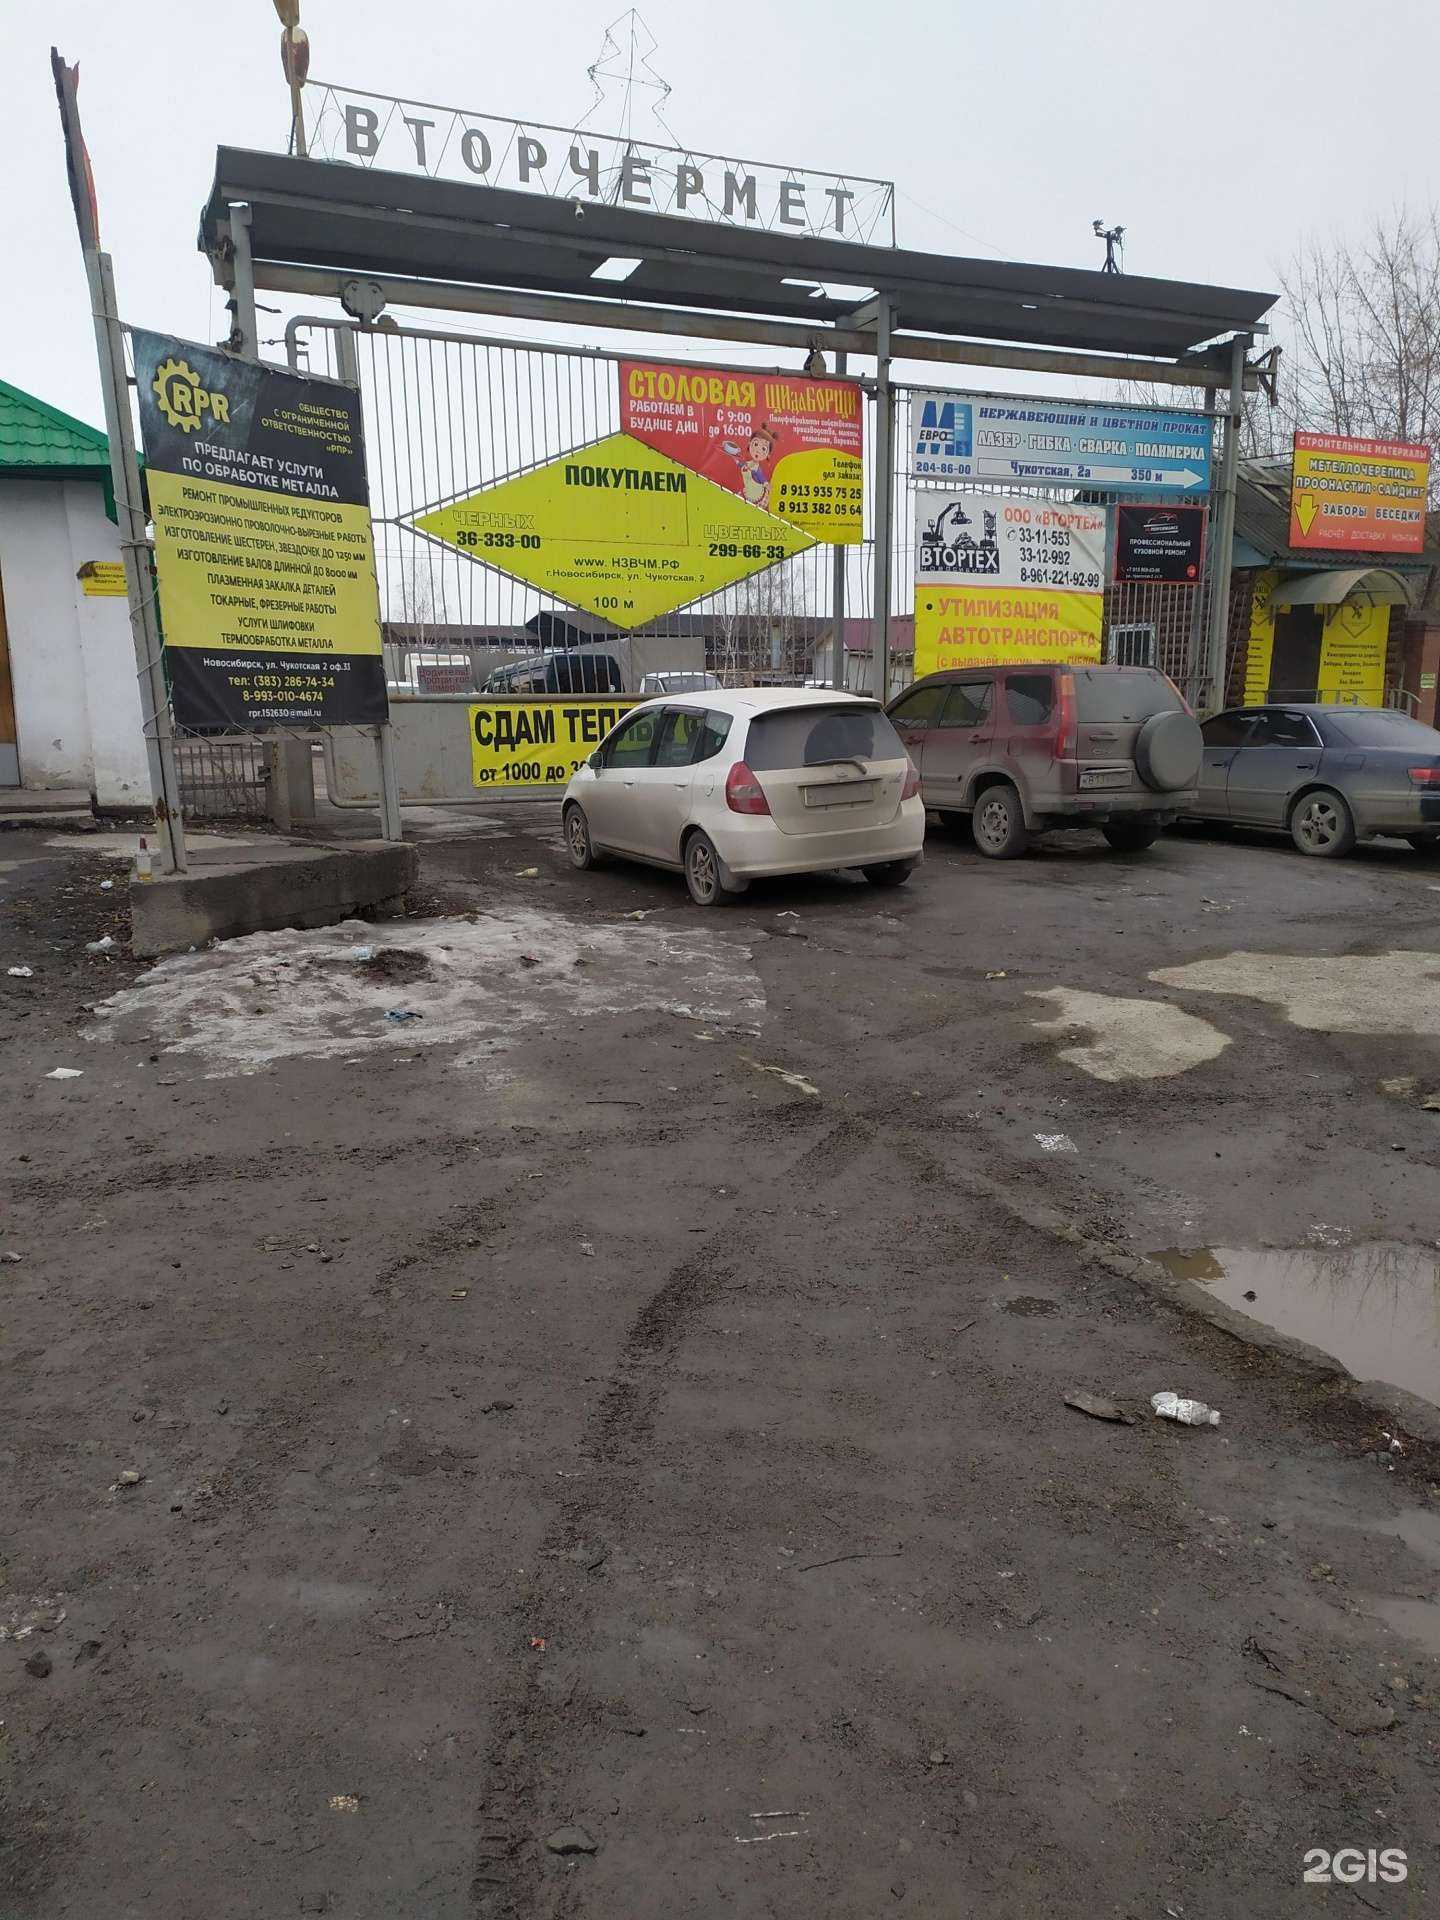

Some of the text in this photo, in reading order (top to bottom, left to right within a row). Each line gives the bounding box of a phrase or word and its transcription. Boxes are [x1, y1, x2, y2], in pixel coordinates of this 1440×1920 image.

[345, 105, 854, 232] ВТОРЧЕРМЕТ
[628, 369, 756, 408] СТОЛОВАЯ
[171, 383, 230, 423] RPR
[299, 402, 348, 420] ОБЩЕСТВО
[630, 400, 694, 415] РАБОТАЕМ В
[274, 408, 350, 431] С ОГРАНИЧЕННОЙ
[716, 409, 751, 423] С 9:00
[979, 407, 1207, 435] НЕРЖАВЕЮЩИЙ И ЦВЕТНОЙ ПРОКАТ
[261, 418, 351, 443] ОТВЕТСТВЕННОСТЬЮ
[630, 419, 698, 434] БУДНИЕ ДНИ
[723, 425, 752, 437] 16:00
[919, 430, 948, 441] ЕВРО
[977, 430, 1205, 460] ЛАЗЕР ГИБКА СВАРКА ПОЛИМЕРКА
[1300, 437, 1427, 458] СТРОИТЕЛЬНЫЕ МАТЕРИАЛЫ
[195, 442, 323, 479] ПРЕДЛАГАЕТ УСЛУГИ
[833, 457, 862, 473] Телефон
[916, 461, 971, 475] 204-86-00
[182, 457, 339, 498] ПО ОБРАБОТКЕ МЕТАЛЛА
[565, 464, 686, 493] ПОКУПАЕМ
[822, 471, 835, 481] для
[1010, 461, 1073, 478] Чукотская,
[1131, 468, 1151, 482] 350
[1154, 473, 1163, 482] м
[780, 484, 862, 499] 8 913 935 75 25
[1296, 476, 1424, 499] ПРОФНАСТИЛ САЙДИНГ
[182, 487, 342, 523] РЕМОНТ ПРОМЫШЛЕННЫХ РЕДУКТОРОВ
[778, 501, 862, 516] 8 913 382 05 64
[1323, 504, 1420, 522] ЗАБОРЫ БЕСЕДКИ
[158, 505, 243, 527] ЭЛЕКТРОЭРОЗИОННО
[244, 519, 335, 541] ПРОВОЛОЧНО-ВЫРЕЗНЫЕ
[452, 510, 537, 530] ЧЕРНЫХ
[1004, 508, 1031, 523] ООО
[456, 531, 541, 549] 36-333-00
[703, 524, 788, 541] ЦВЕТНЫХ
[1019, 528, 1070, 546] 33-11-553
[164, 526, 232, 545] ИЗГОТОВЛЕНИЕ
[234, 533, 277, 552] ШЕСТЕРЕН,
[279, 541, 320, 557] ЗВЕЗДОЧЕК
[322, 548, 334, 560] ДО
[335, 551, 351, 561] 1250
[709, 543, 784, 559] 299-66-33
[1129, 538, 1191, 547] ПРОФЕССИОНАЛЬНЫЙ
[1133, 547, 1163, 555] КУЗОВНОЙ
[177, 548, 244, 567] ИЗГОТОВЛЕНИЕ
[246, 556, 272, 570] ВАЛОВ
[274, 560, 312, 576] ДЛИННОЙ
[313, 567, 324, 579] ДО
[326, 568, 347, 578] 8000
[922, 547, 998, 569] ВТОРТЕХ
[1020, 547, 1070, 566] 33-12-992
[208, 573, 336, 596] ПЛАЗМЕННАЯ ЗАКАЛКА ДЕТАЛЕЙ
[627, 573, 641, 584] ул.
[700, 574, 705, 583] 2
[1021, 567, 1100, 588] 8-961-221-92-99
[210, 594, 337, 614] ТОКАРНЫЕ, ФРЕЗЕРНЫЕ РАБОТЫ
[593, 597, 634, 609] 100 м
[938, 598, 1058, 621] УТИЛИЗАЦИЯ
[238, 617, 315, 631] УСЛУГИ ШЛИФОВКИ
[221, 632, 333, 649] ТЕРМООБРАБОТКА МЕТАЛЛА
[938, 627, 1096, 648] АВТОТРАНСПОРТА
[203, 658, 263, 669] Новосибирск,
[265, 660, 278, 671] ул.
[280, 660, 320, 672] Чукотская
[322, 662, 328, 671] 2
[228, 675, 335, 688] тел: (383) 286-74-34
[243, 690, 323, 702] 8-993-010-4674
[475, 709, 632, 752] СДАМ ТЕП
[480, 769, 497, 781] от
[502, 762, 540, 780] 1000
[545, 766, 564, 782] до
